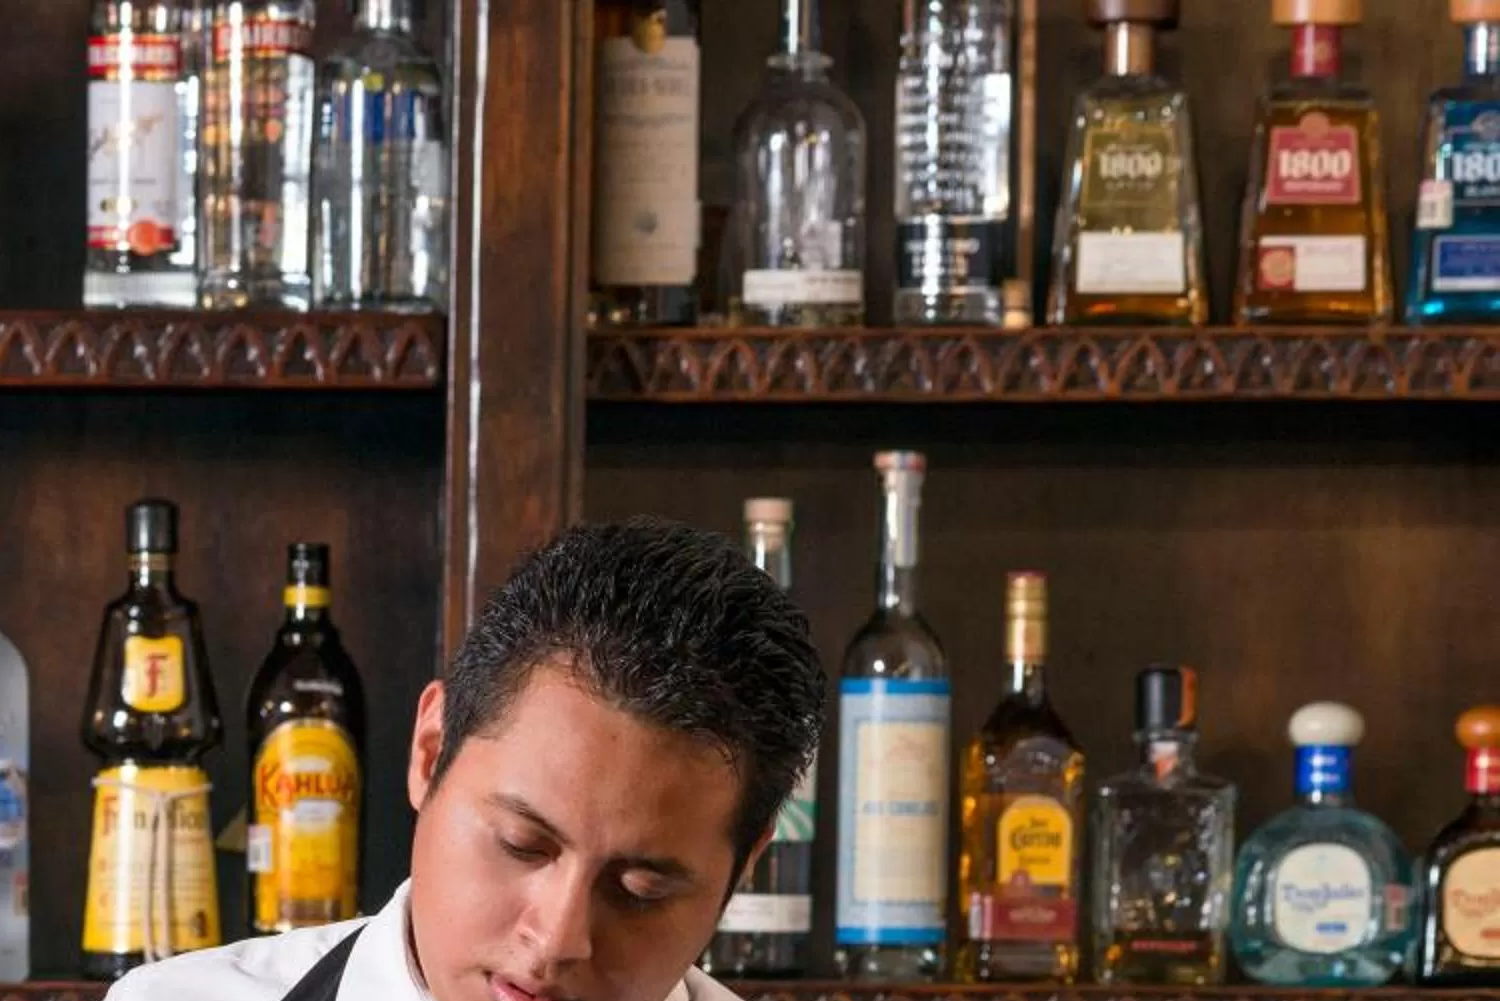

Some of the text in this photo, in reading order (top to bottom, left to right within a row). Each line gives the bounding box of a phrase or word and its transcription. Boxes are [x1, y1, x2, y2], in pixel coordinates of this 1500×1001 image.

[1100, 151, 1164, 180] 1800
[1279, 149, 1351, 179] 1800
[1452, 151, 1500, 182] 180
